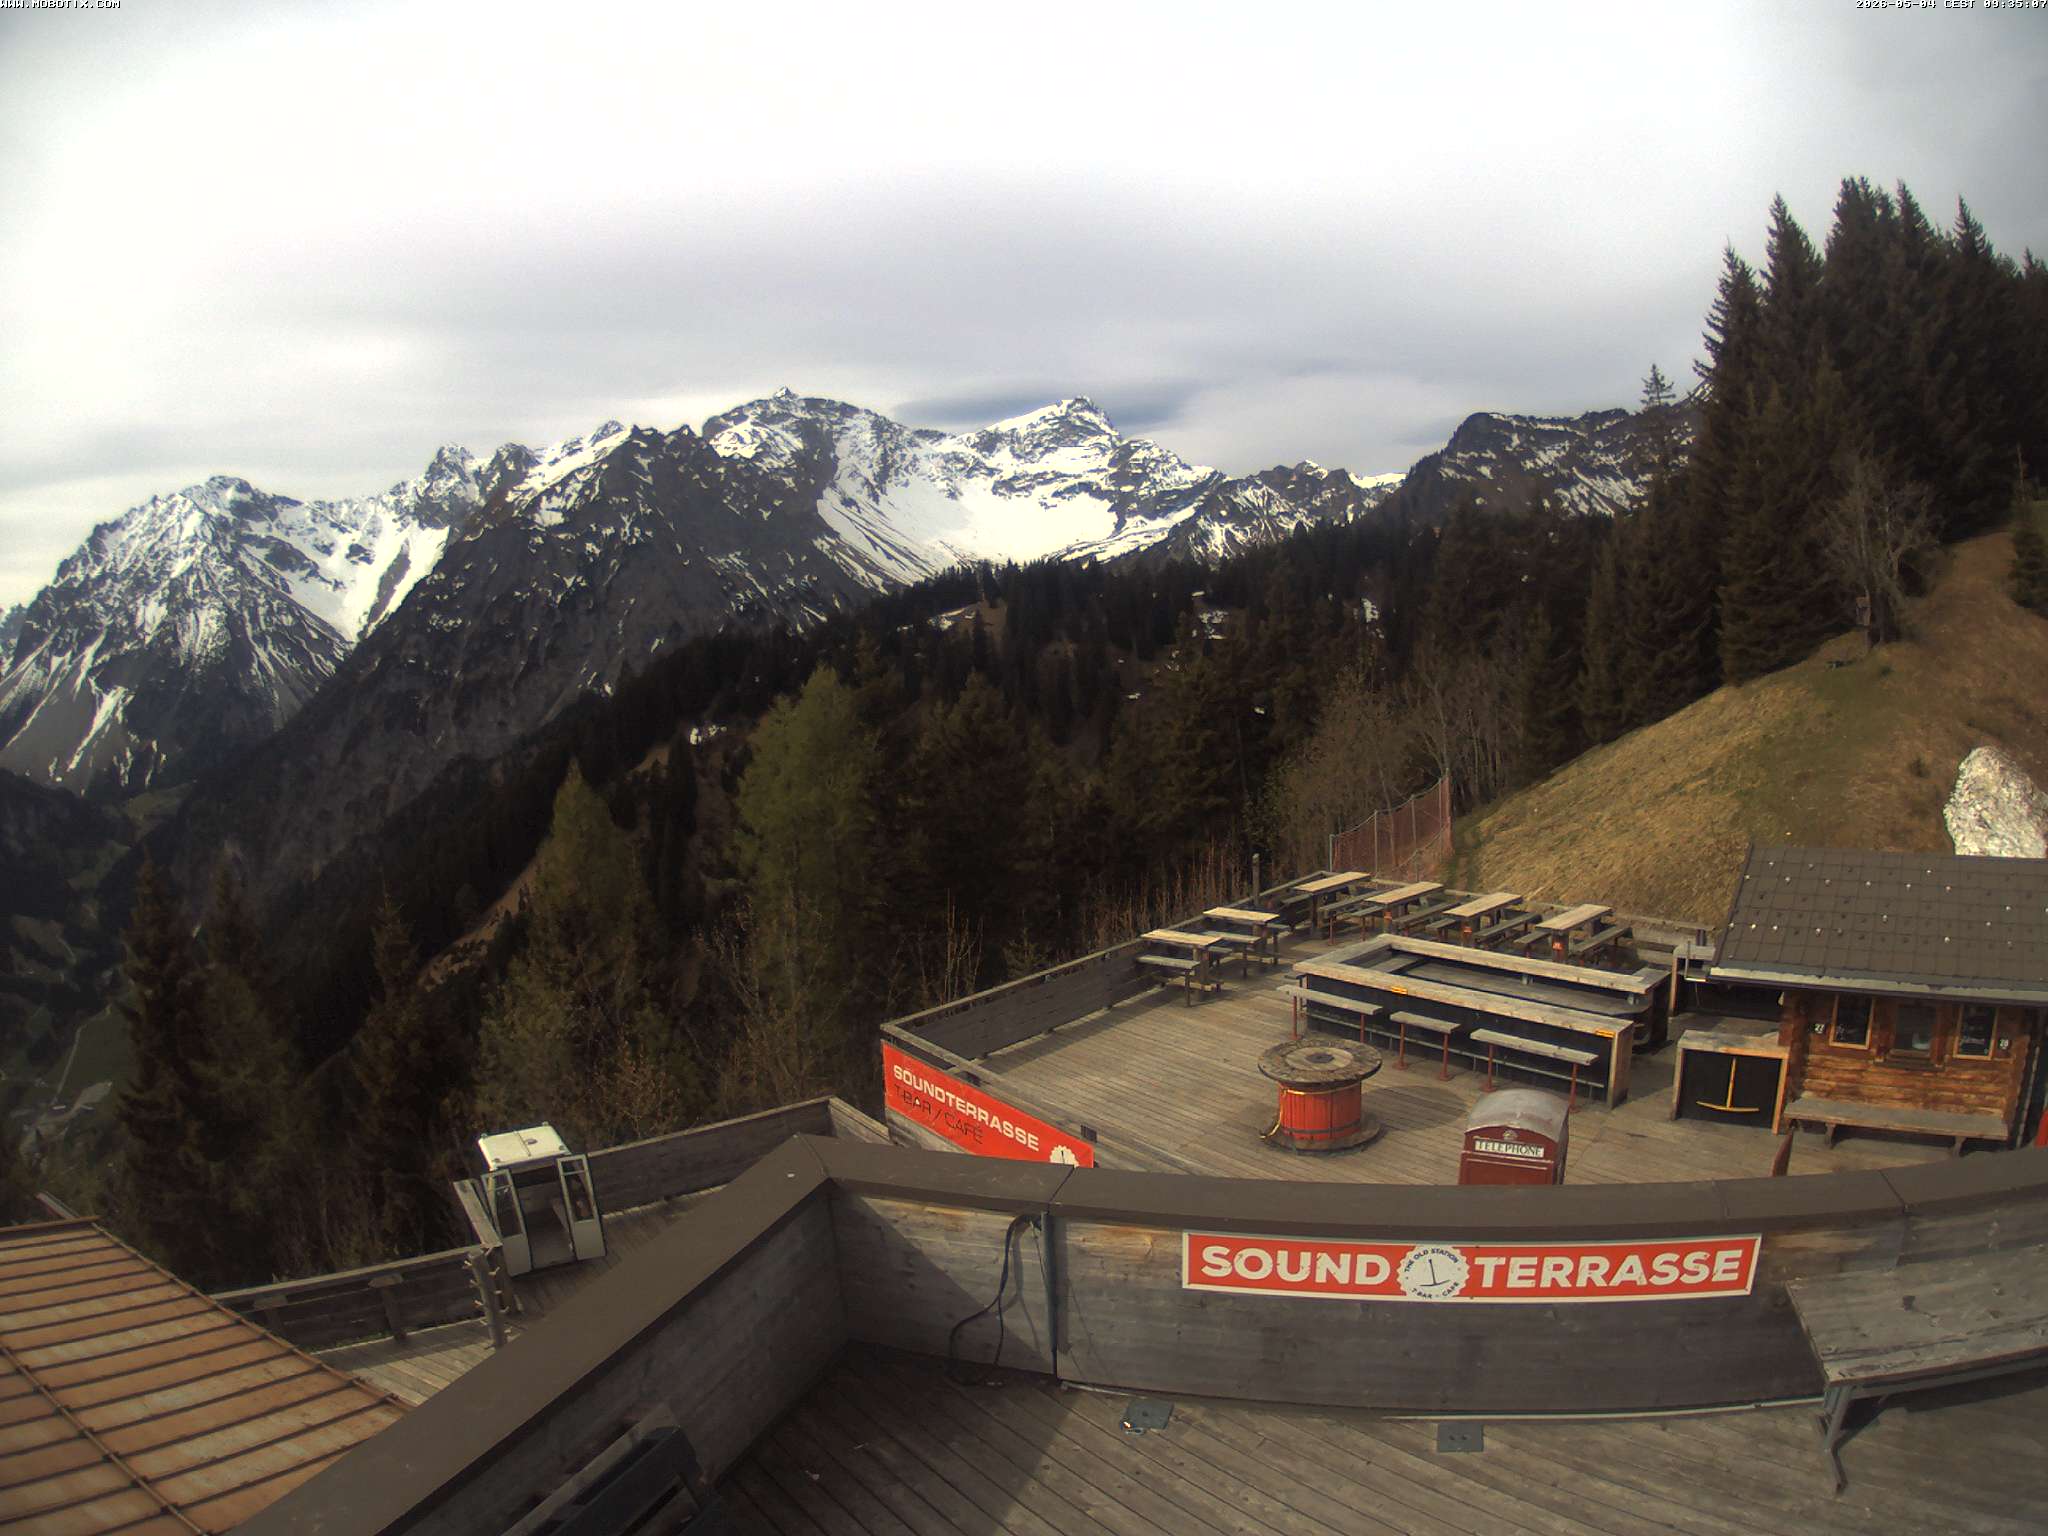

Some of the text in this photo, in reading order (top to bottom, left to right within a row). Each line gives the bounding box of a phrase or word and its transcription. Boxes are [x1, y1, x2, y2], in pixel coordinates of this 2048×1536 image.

[893, 1064, 1040, 1152] SOUNDTERRASSE
[1477, 1141, 1542, 1157] TELEPHONE
[1200, 1245, 1743, 1289] SOUND TERRASSE
[1404, 1247, 1459, 1272] THE OLD STATION
